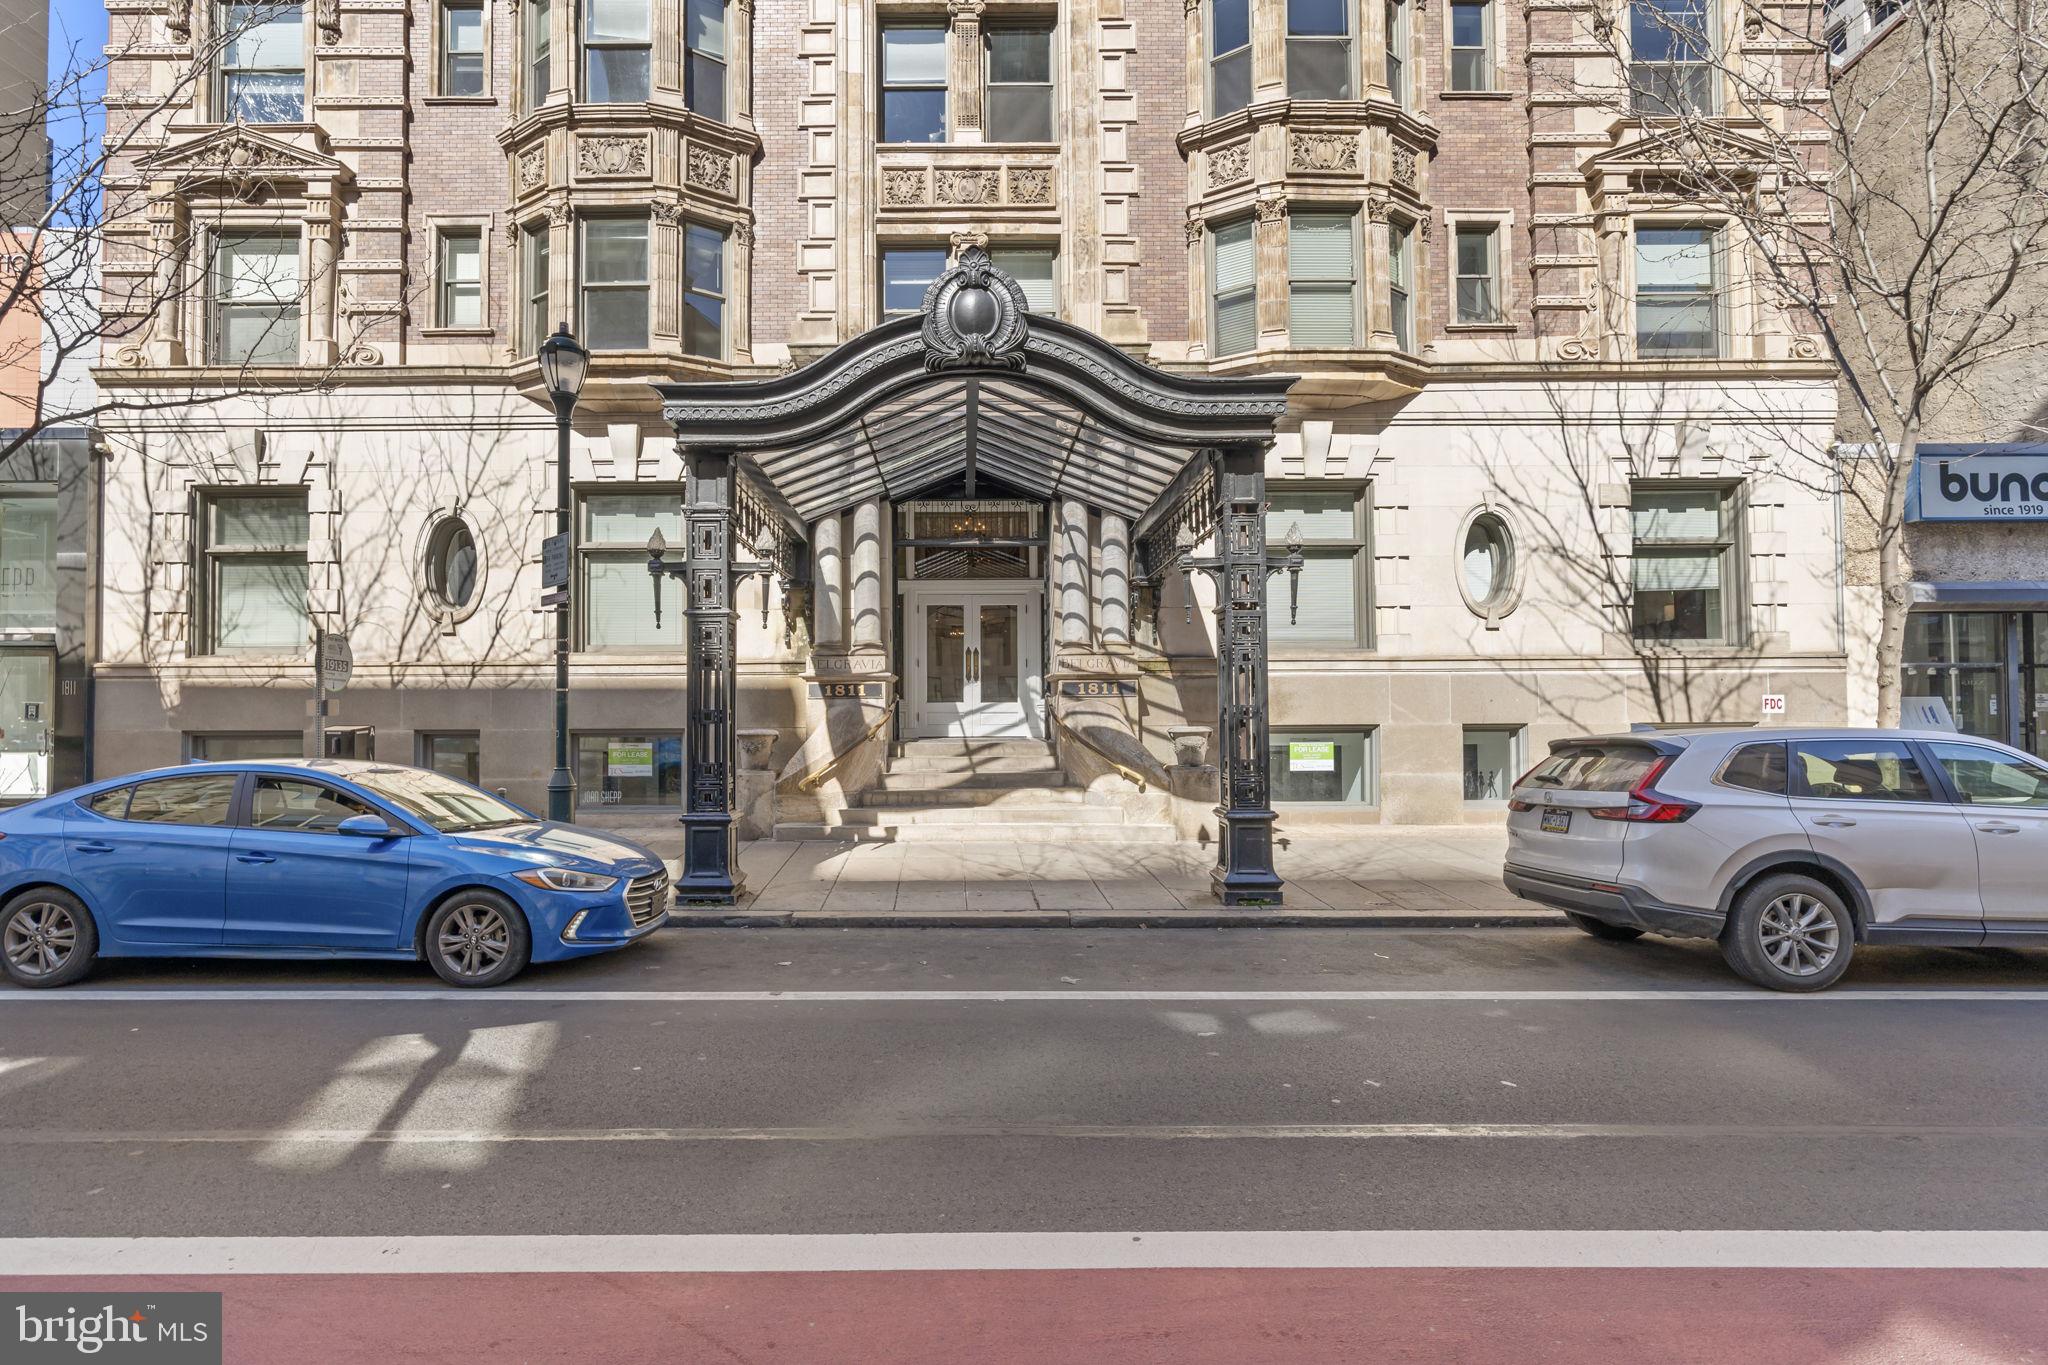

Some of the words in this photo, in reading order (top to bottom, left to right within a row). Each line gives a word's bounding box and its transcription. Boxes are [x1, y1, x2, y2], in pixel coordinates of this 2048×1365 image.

[1983, 504, 2014, 515] since
[2017, 504, 2044, 515] 1919
[326, 659, 348, 672] 19135
[807, 659, 884, 670] BELGRAVIA
[1061, 658, 1135, 669] BELGRAVIA
[62, 680, 77, 696] 1811
[825, 684, 866, 696] 1811
[1078, 682, 1120, 695] 1811
[1764, 698, 1783, 710] FDC
[582, 790, 599, 803] JOAN
[600, 790, 622, 804] SHEPP
